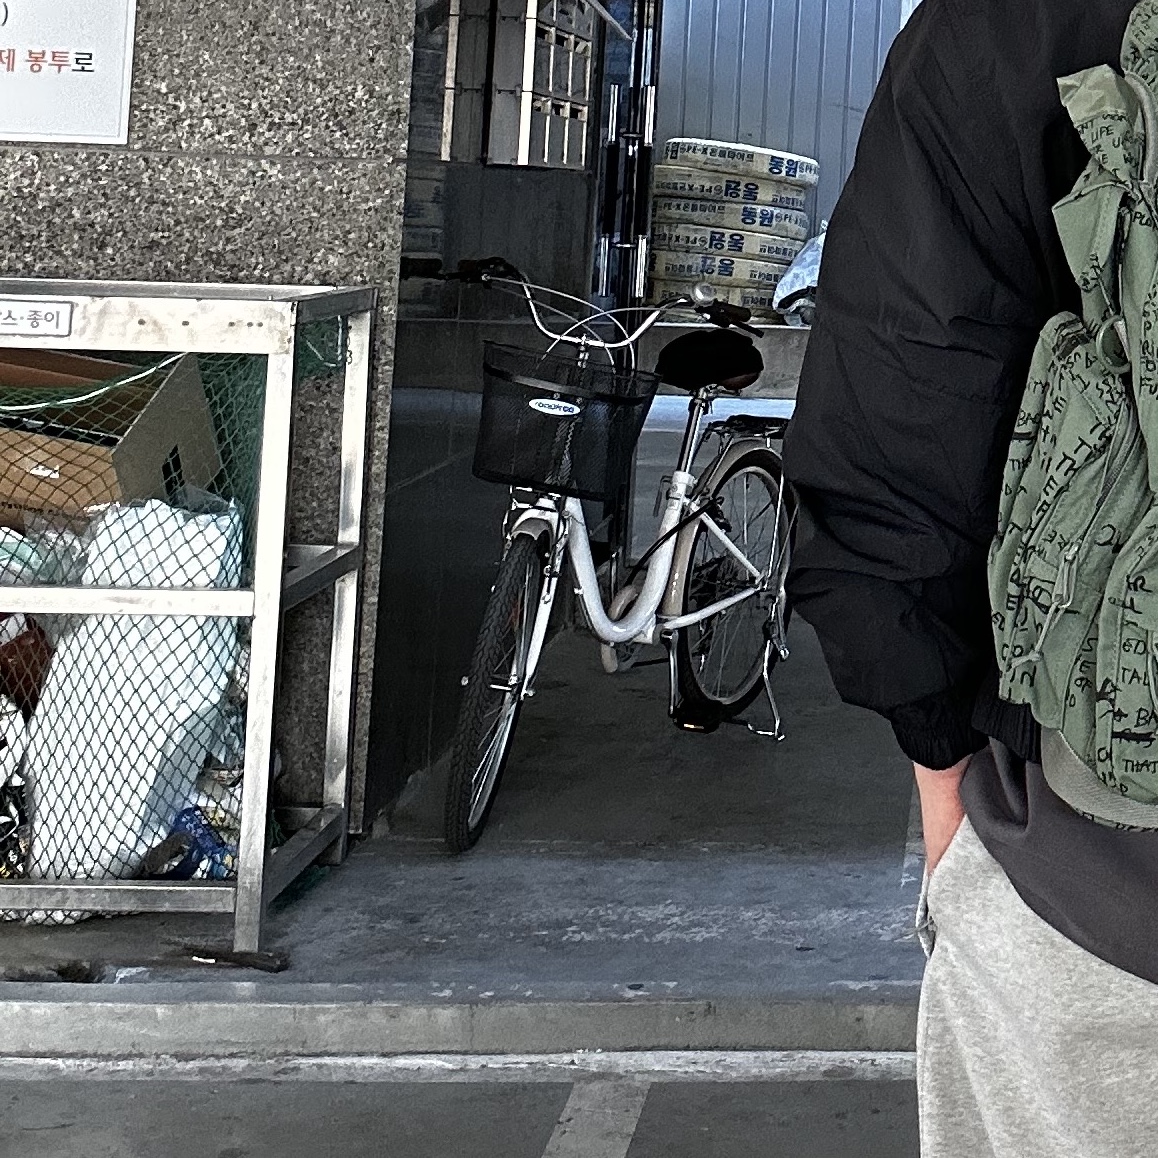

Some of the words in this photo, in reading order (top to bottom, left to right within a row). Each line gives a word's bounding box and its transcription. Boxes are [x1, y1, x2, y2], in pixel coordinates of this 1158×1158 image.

[25, 48, 95, 74] 봉투로
[768, 155, 799, 178] 동원
[724, 179, 760, 202] 동원
[741, 205, 775, 228] 동원
[709, 230, 745, 253] 동원
